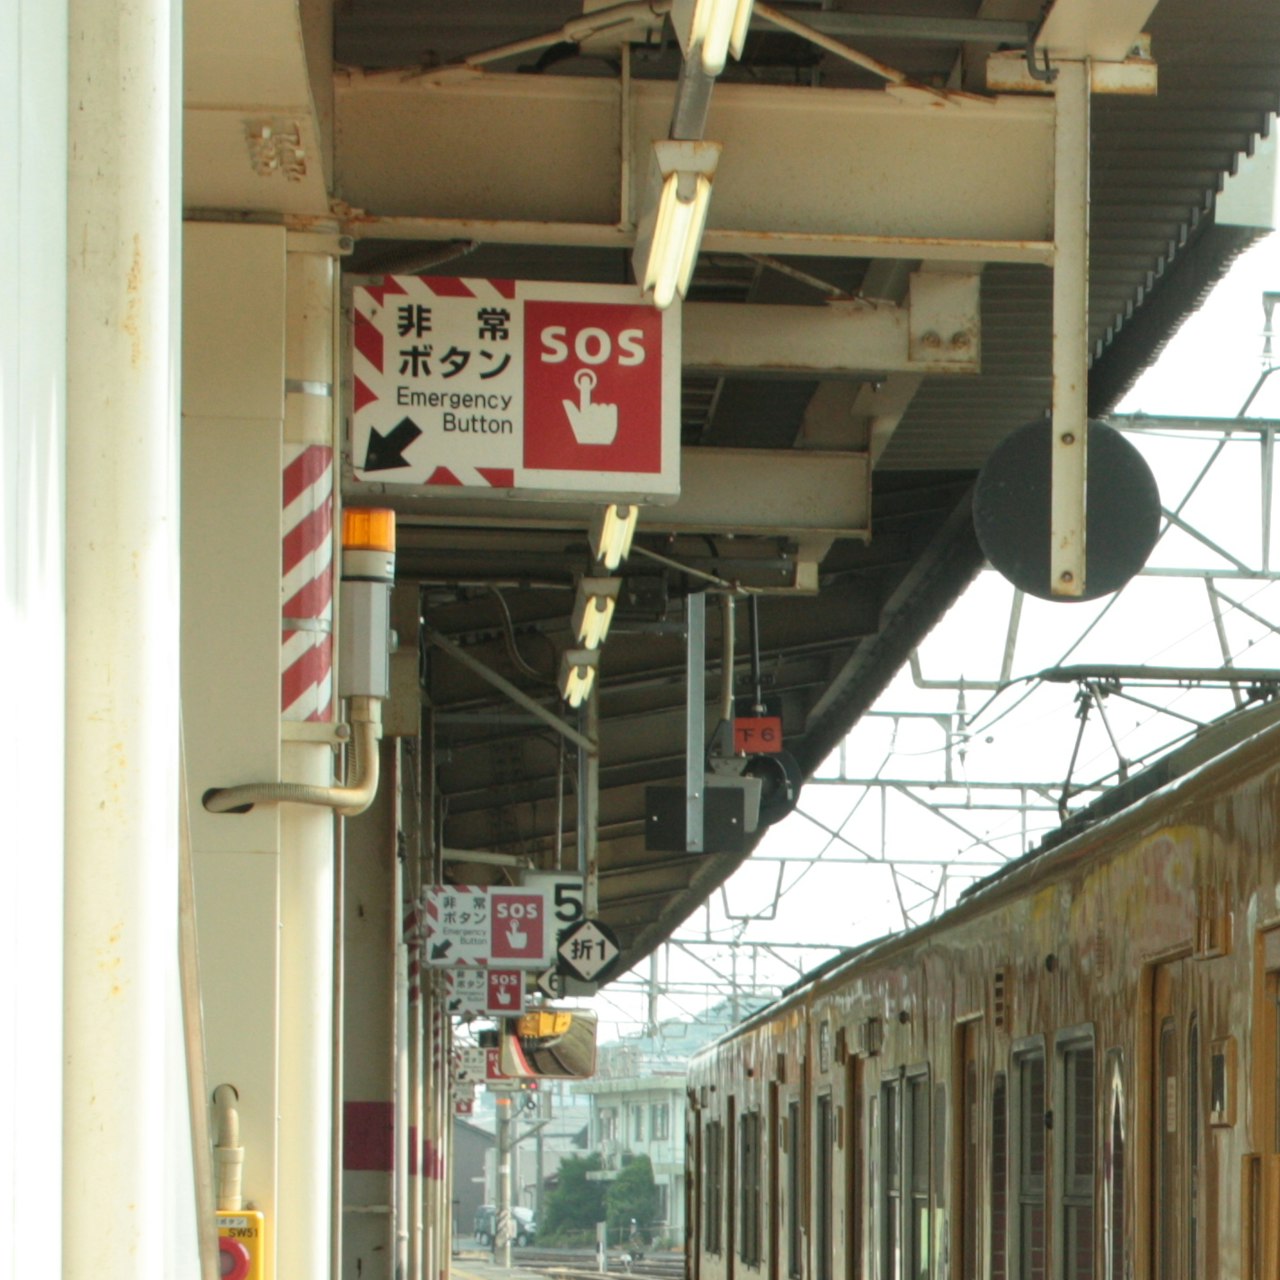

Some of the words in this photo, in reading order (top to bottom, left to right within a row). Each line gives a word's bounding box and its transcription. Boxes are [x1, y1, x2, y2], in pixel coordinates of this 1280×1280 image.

[397, 304, 511, 341] 非常
[540, 325, 646, 367] SOS
[398, 344, 512, 380] ボタン
[396, 386, 512, 412] Emergency
[442, 413, 513, 434] Button
[497, 902, 538, 919] SOS
[554, 883, 583, 922] 5
[443, 911, 487, 925] ボタン
[442, 927, 487, 936] Emergency
[460, 936, 488, 945] Button
[571, 938, 606, 960] 折1
[490, 974, 518, 985] SOS
